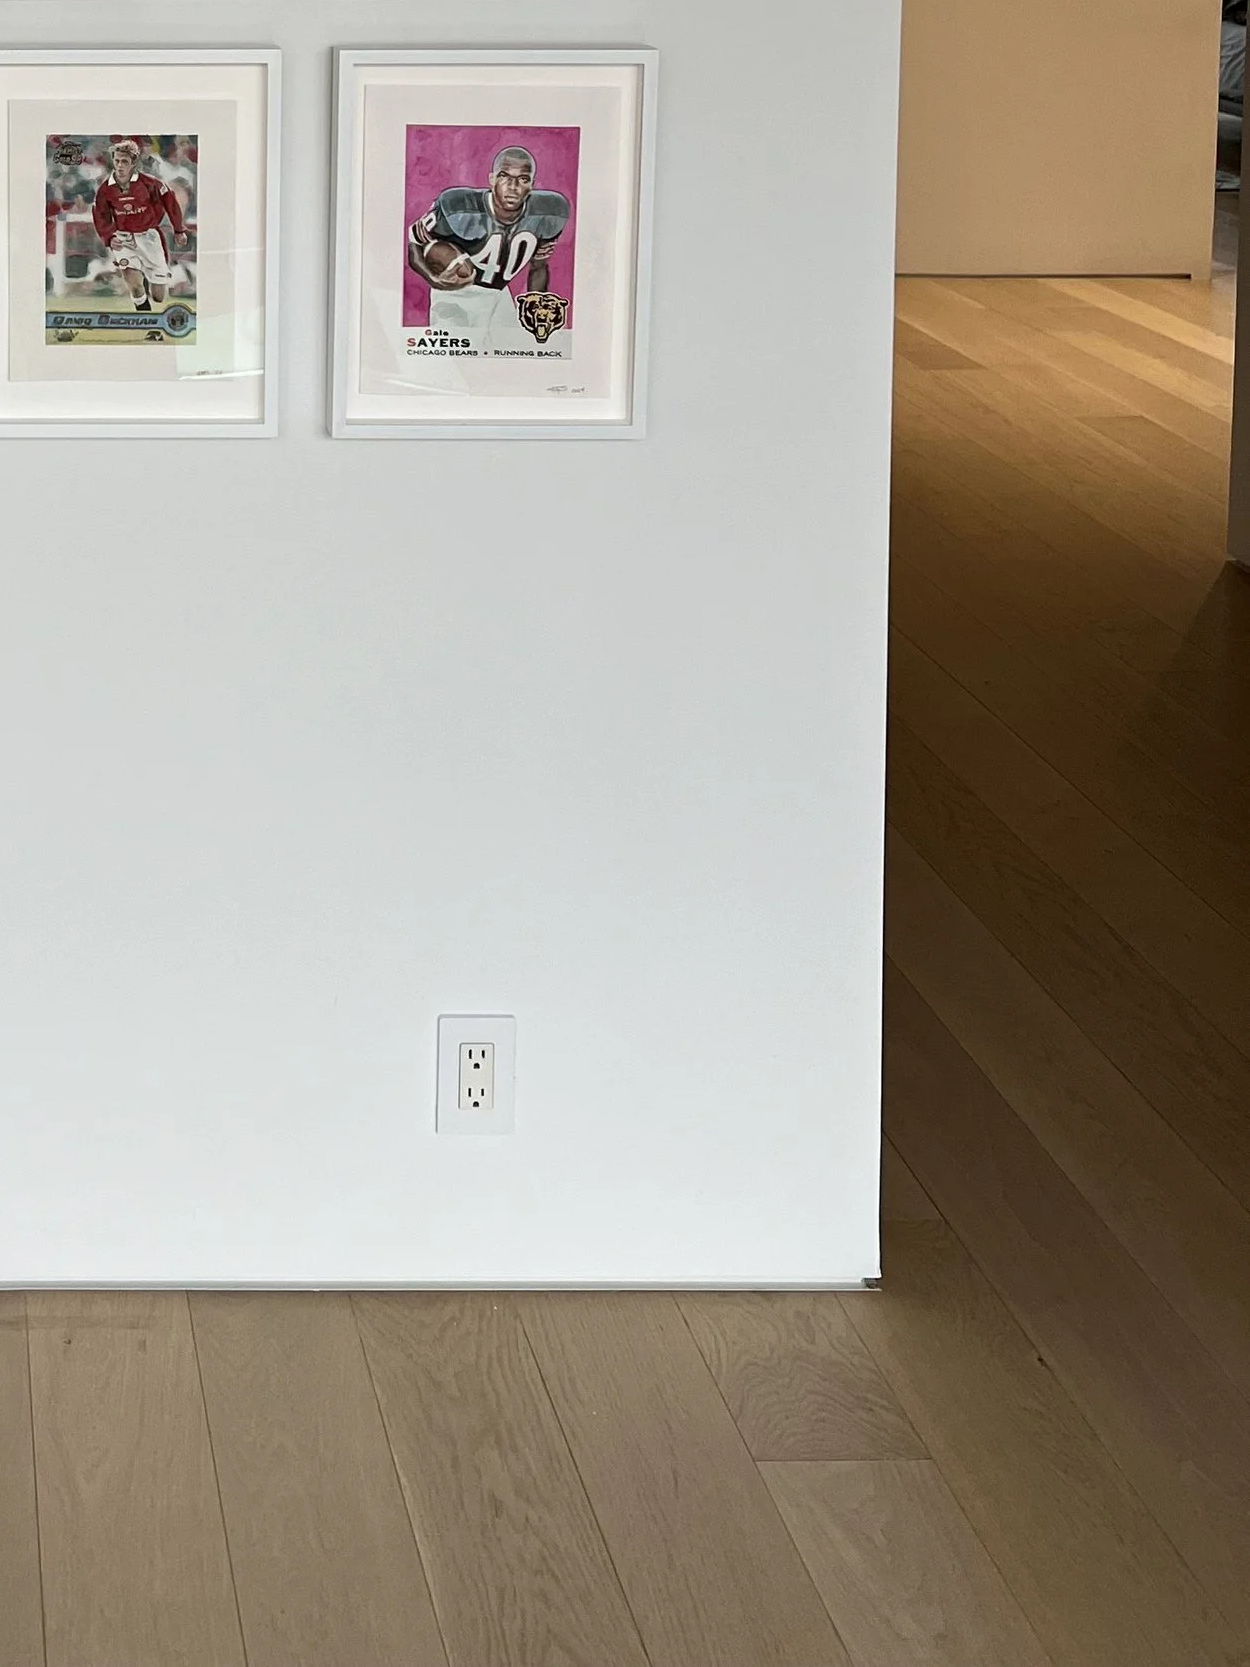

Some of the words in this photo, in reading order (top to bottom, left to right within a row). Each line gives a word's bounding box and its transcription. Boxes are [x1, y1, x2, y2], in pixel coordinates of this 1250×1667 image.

[469, 231, 538, 284] 40
[406, 337, 471, 348] SAYERS
[493, 349, 535, 357] RUNNING
[536, 350, 563, 358] BACK
